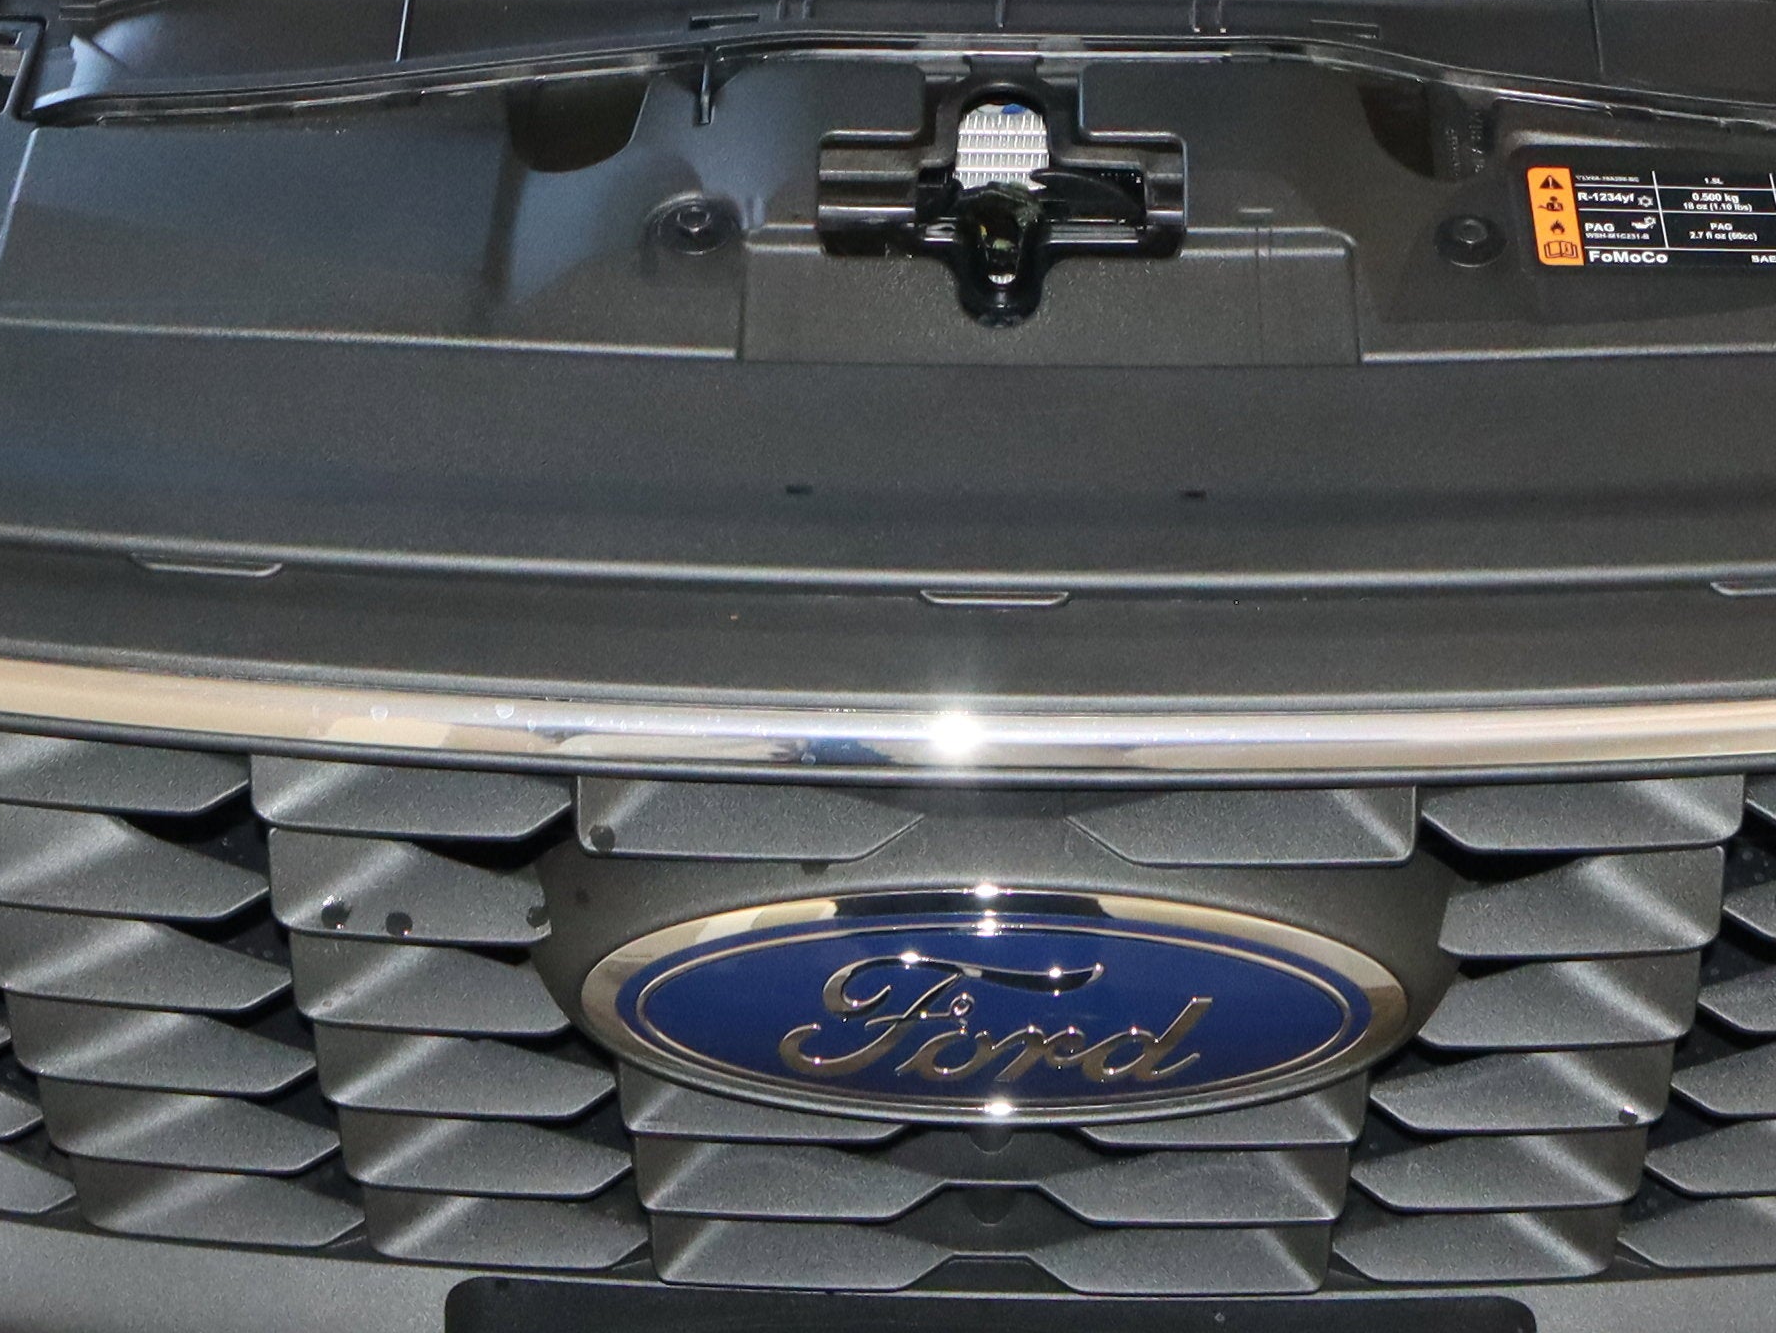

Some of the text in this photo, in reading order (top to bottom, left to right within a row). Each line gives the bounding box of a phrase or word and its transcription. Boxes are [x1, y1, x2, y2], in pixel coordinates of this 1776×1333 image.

[1577, 192, 1635, 203] R-1234yf
[1691, 193, 1740, 204] 0.500 kg
[1584, 222, 1615, 232] PAG
[1710, 223, 1733, 231] PAG
[1689, 231, 1704, 240] 2.7
[1705, 231, 1713, 240] fl
[1588, 251, 1669, 264] FoMoCo
[779, 951, 1214, 1085] Ford
